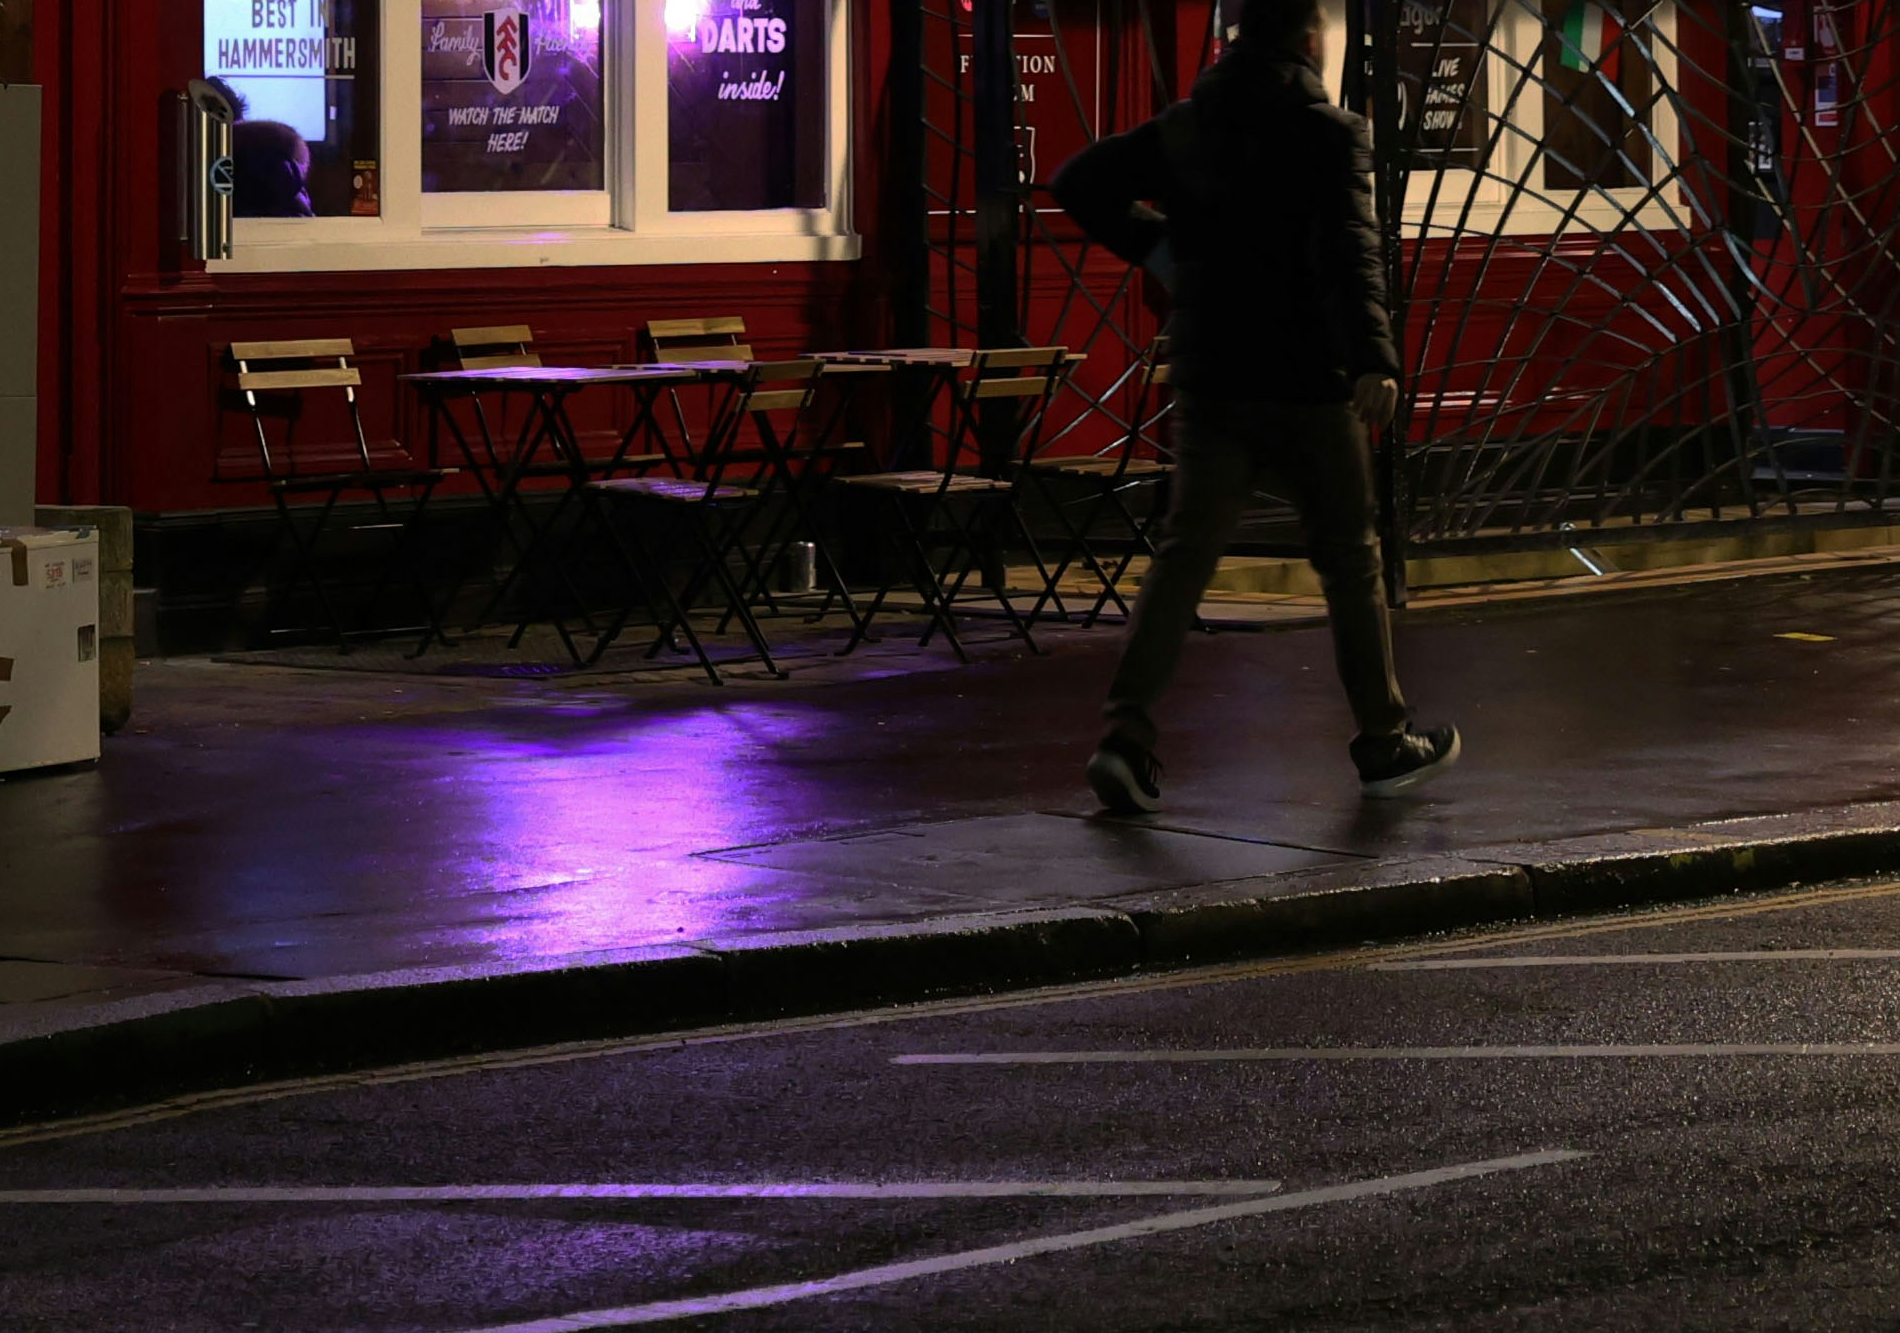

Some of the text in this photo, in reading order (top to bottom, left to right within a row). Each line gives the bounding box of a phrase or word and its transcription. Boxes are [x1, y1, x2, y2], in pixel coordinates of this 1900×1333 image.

[700, 17, 787, 54] DARTS
[218, 37, 356, 69] HAMMERSMITH
[718, 70, 785, 101] inside!
[448, 104, 560, 126] WATCH THE MATCH
[1422, 109, 1463, 131] SHOW
[486, 131, 529, 153] HERE!
